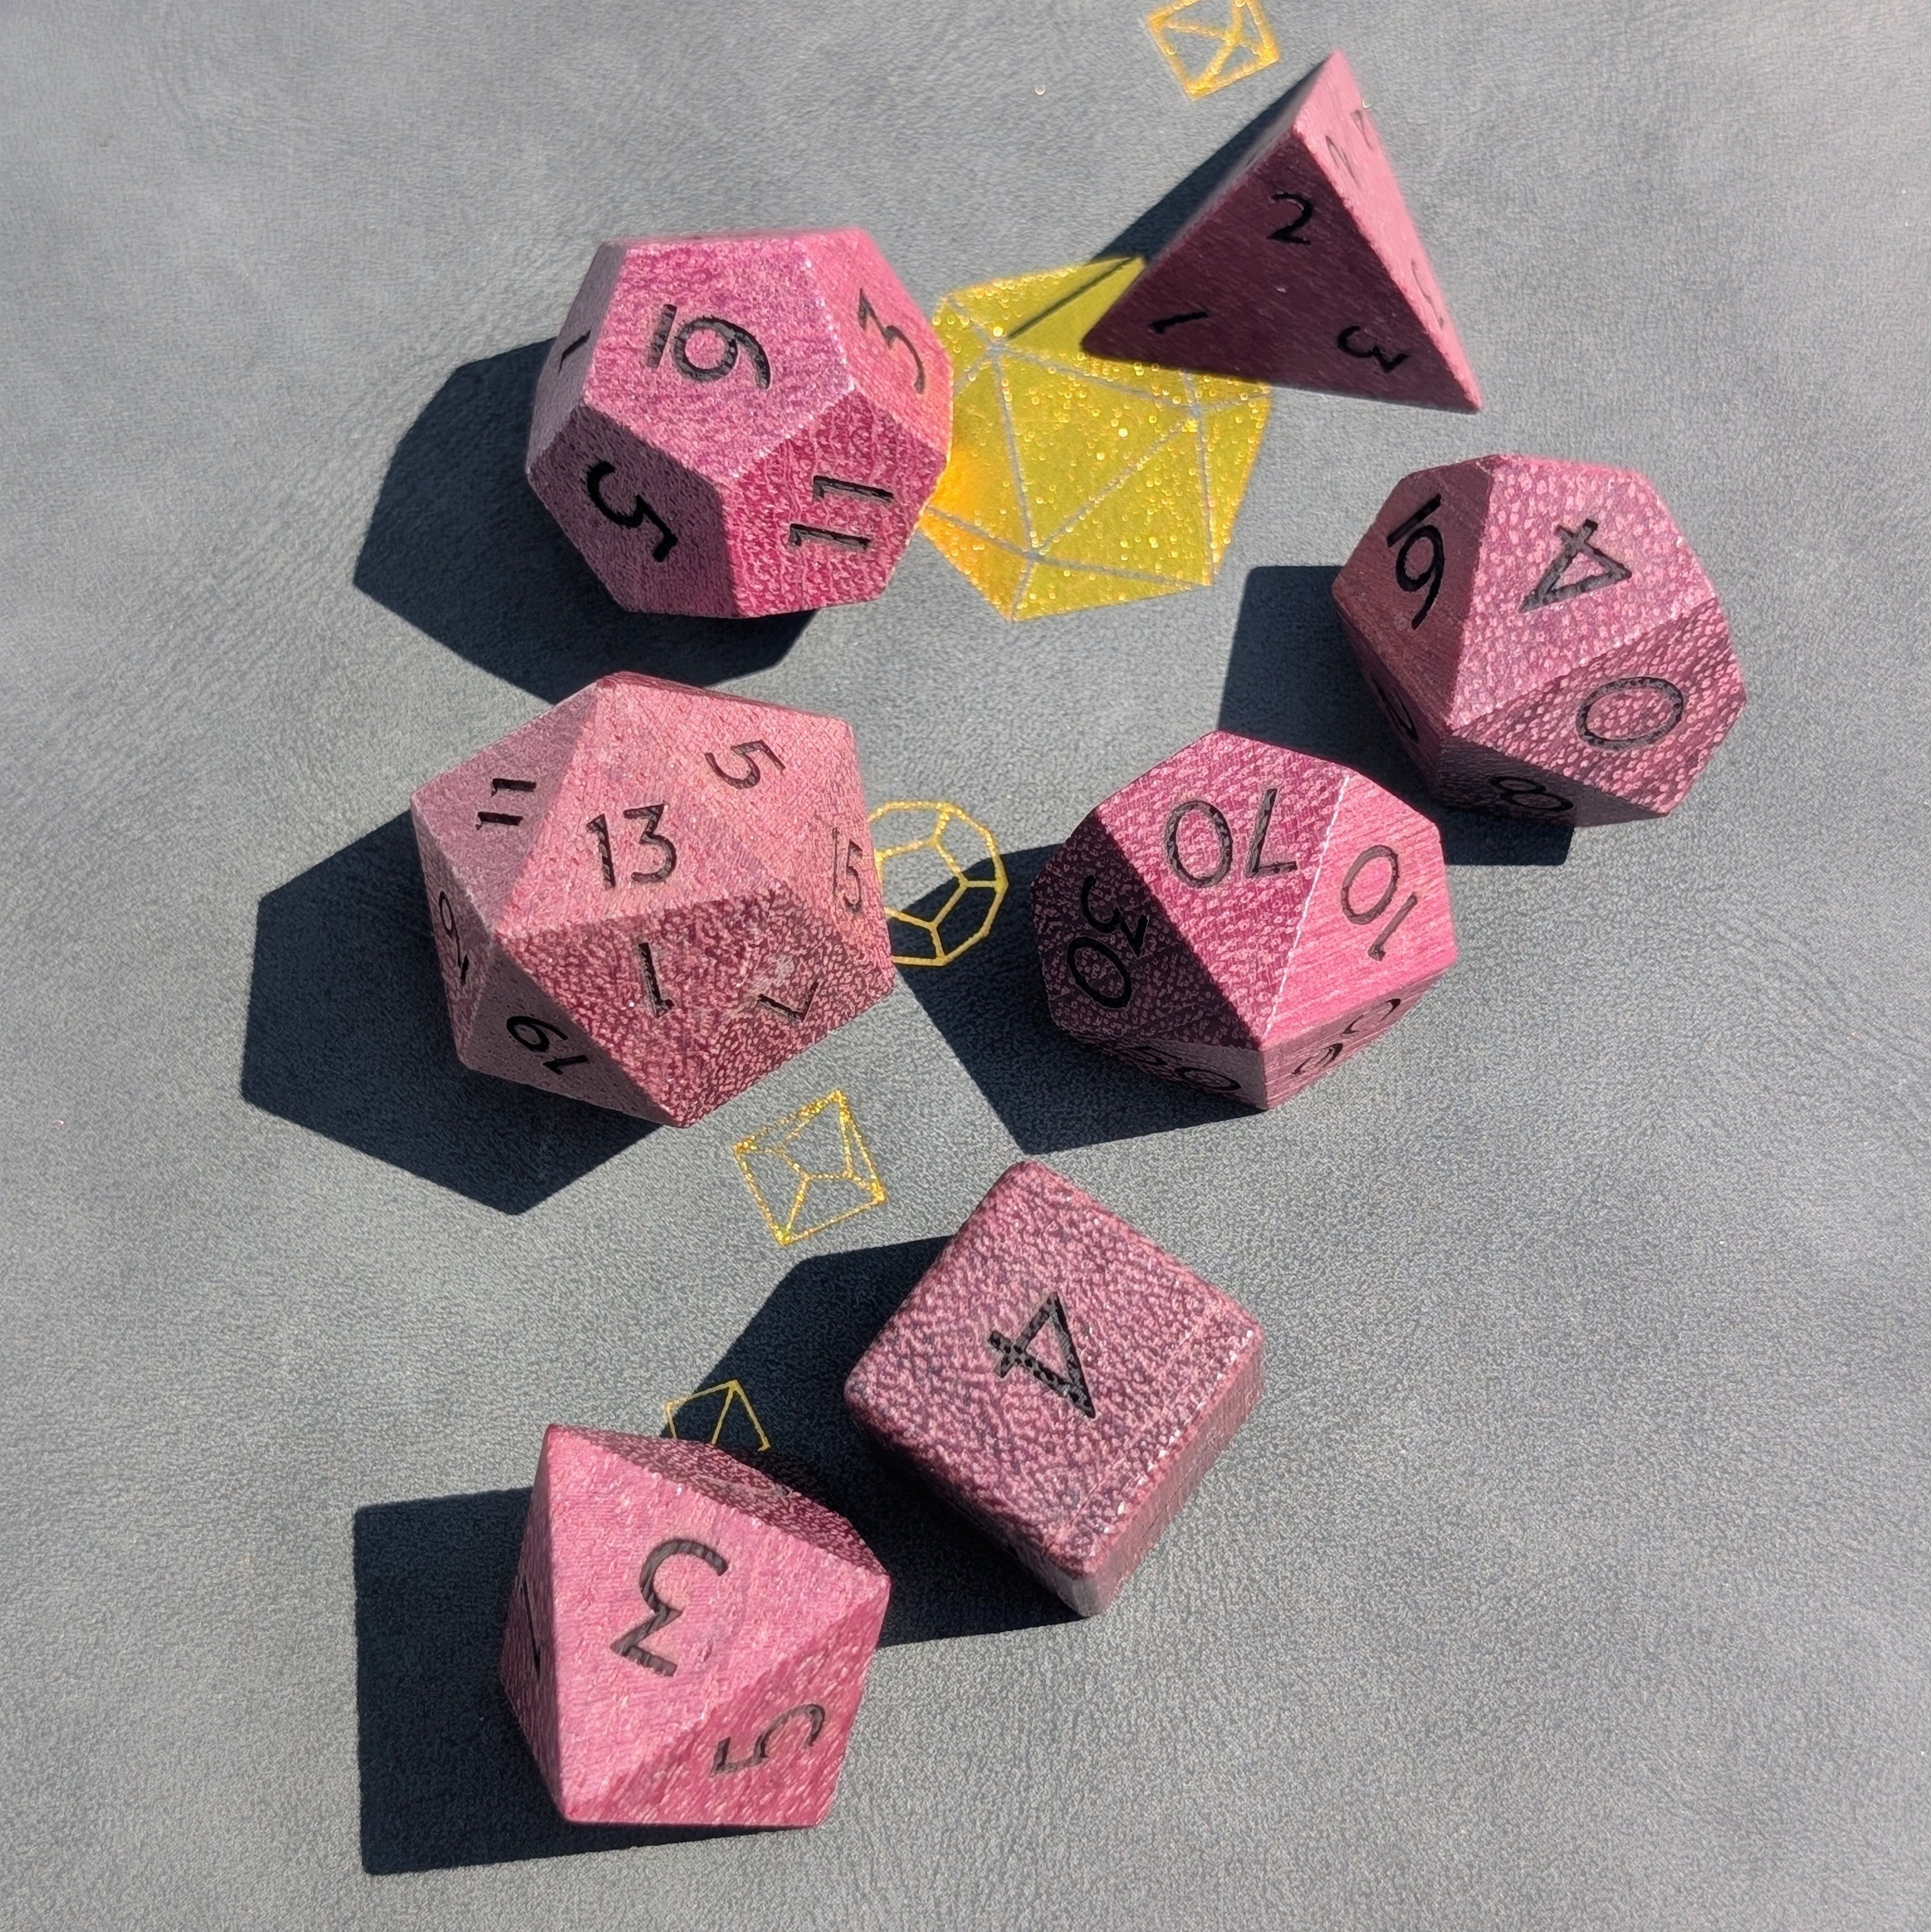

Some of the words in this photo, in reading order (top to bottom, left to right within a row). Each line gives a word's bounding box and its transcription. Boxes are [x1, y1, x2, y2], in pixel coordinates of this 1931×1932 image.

[1267, 192, 1312, 245] 2
[645, 304, 771, 391] 6
[857, 287, 925, 395] 3
[1148, 311, 1209, 334] 1
[1337, 326, 1409, 373] 3
[583, 461, 679, 563] 5
[787, 475, 894, 549] 11
[1387, 493, 1445, 630] 6
[1519, 519, 1632, 613] 4
[1575, 676, 1684, 752] 0
[475, 777, 537, 830] 11
[704, 739, 786, 789] 5
[1490, 775, 1574, 812] 8
[586, 802, 678, 889] 13
[832, 826, 864, 915] 15
[1164, 788, 1299, 889] 70
[1066, 875, 1149, 1008] 30
[1341, 843, 1419, 962] 10
[637, 941, 676, 1018] 1
[755, 980, 819, 1024] 7
[506, 1015, 589, 1075] 19
[986, 1290, 1098, 1420] 4
[610, 1537, 730, 1677] 3
[709, 1702, 826, 1779] 5
